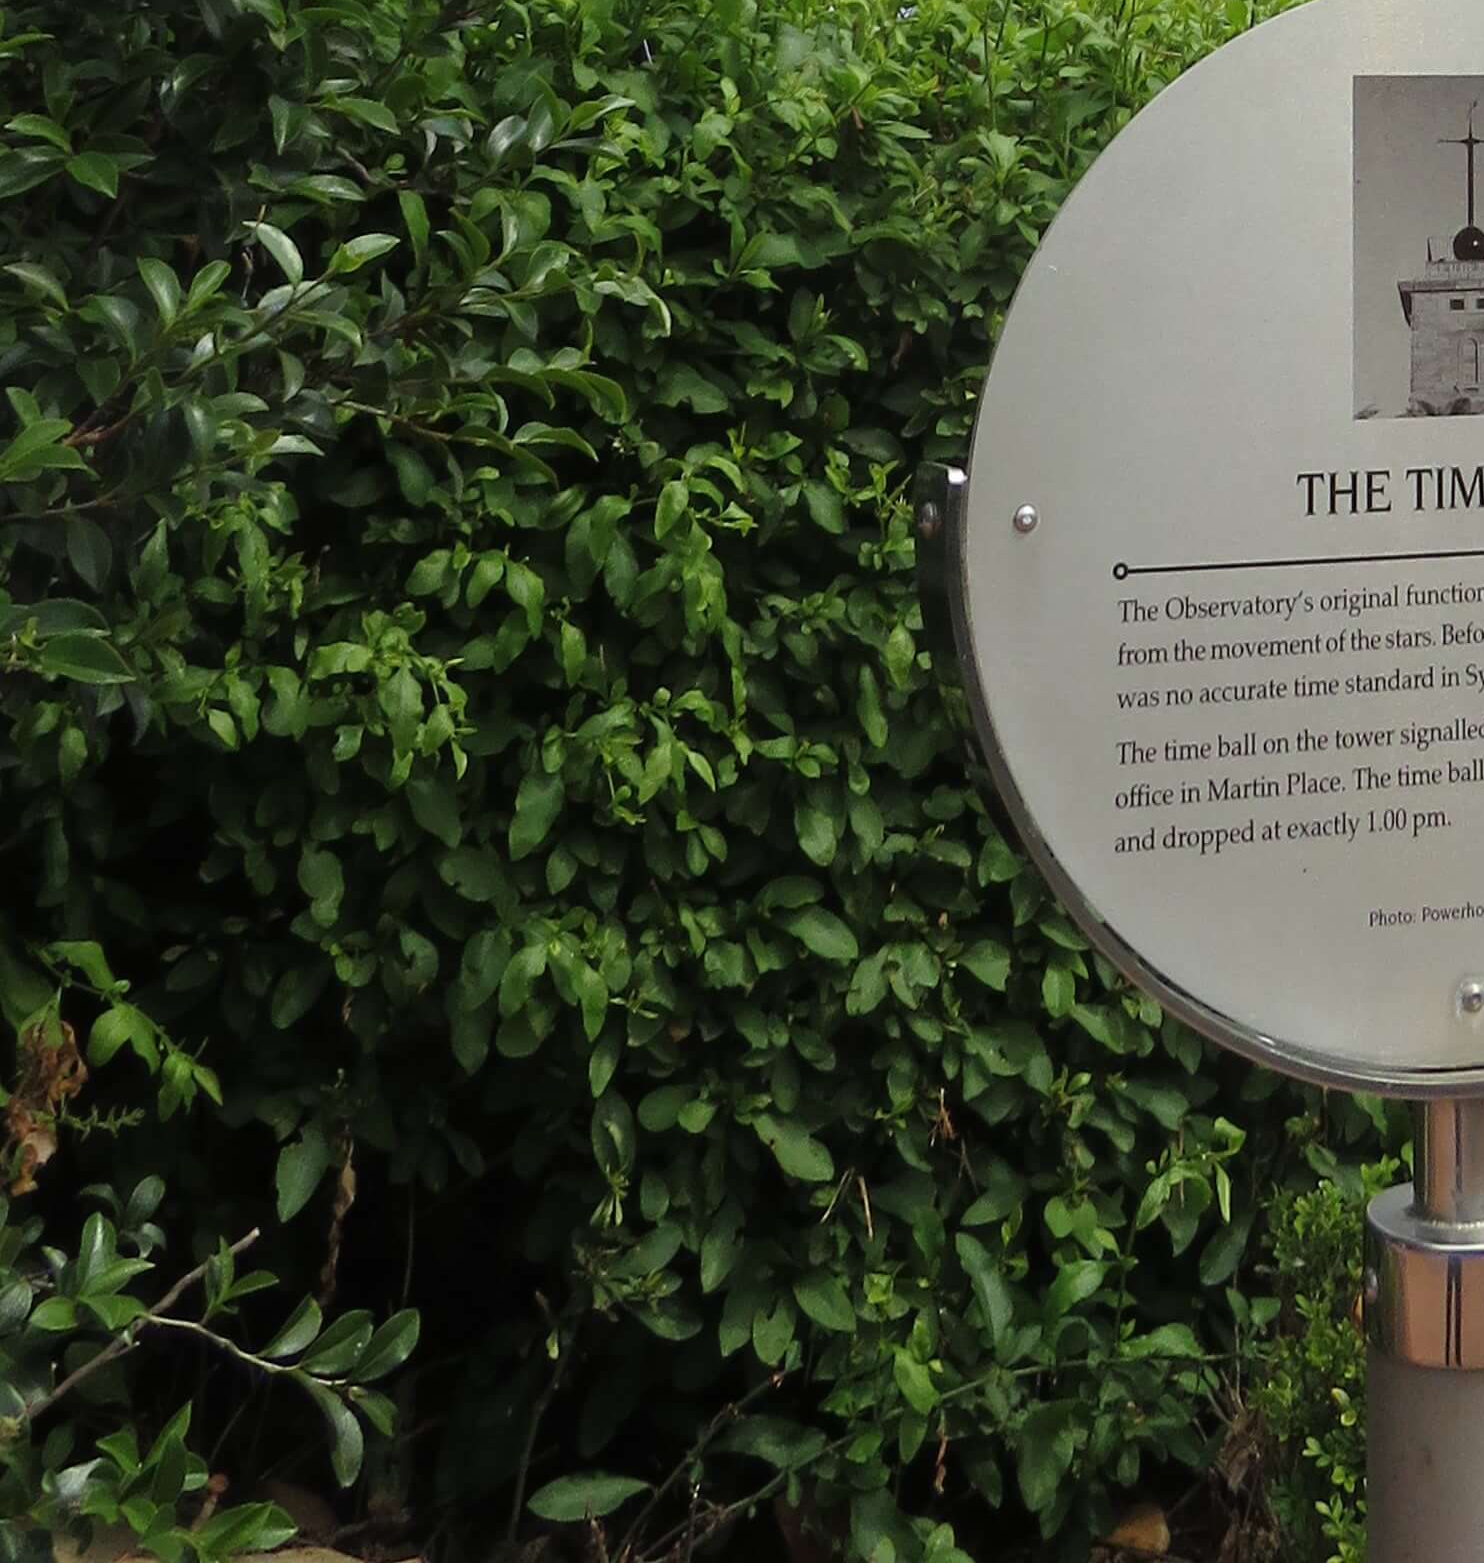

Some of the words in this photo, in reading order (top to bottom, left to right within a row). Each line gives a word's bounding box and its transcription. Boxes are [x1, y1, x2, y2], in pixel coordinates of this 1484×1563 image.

[1296, 470, 1392, 516] THE
[1117, 598, 1159, 623] The
[1165, 590, 1314, 622] Observatory's
[1320, 584, 1399, 618] original
[1118, 642, 1168, 666] from
[1174, 639, 1207, 662] the
[1210, 634, 1322, 660] movement
[1325, 628, 1347, 653] of
[1350, 627, 1381, 652] the
[1385, 629, 1436, 650] stars.
[1117, 691, 1160, 709] was
[1166, 688, 1193, 706] no
[1199, 679, 1288, 704] accurate
[1294, 675, 1340, 698] time
[1345, 666, 1434, 695] standard
[1441, 665, 1460, 688] in
[1116, 740, 1157, 765] The
[1164, 739, 1212, 762] time
[1218, 732, 1257, 758] ball
[1263, 737, 1290, 755] on
[1296, 728, 1329, 752] the
[1335, 729, 1395, 750] tower
[1115, 783, 1174, 809] office
[1181, 781, 1201, 804] in
[1208, 775, 1280, 802] Martin
[1286, 771, 1346, 796] Place.
[1352, 766, 1391, 791] The
[1398, 764, 1443, 787] time
[1447, 758, 1484, 783] ball
[1114, 827, 1155, 853] and
[1162, 818, 1254, 855] dropped
[1261, 820, 1282, 841] at
[1287, 811, 1361, 843] exactly
[1367, 807, 1407, 833] 1.00
[1412, 811, 1451, 838] pm.
[1369, 909, 1416, 927] Photo:
